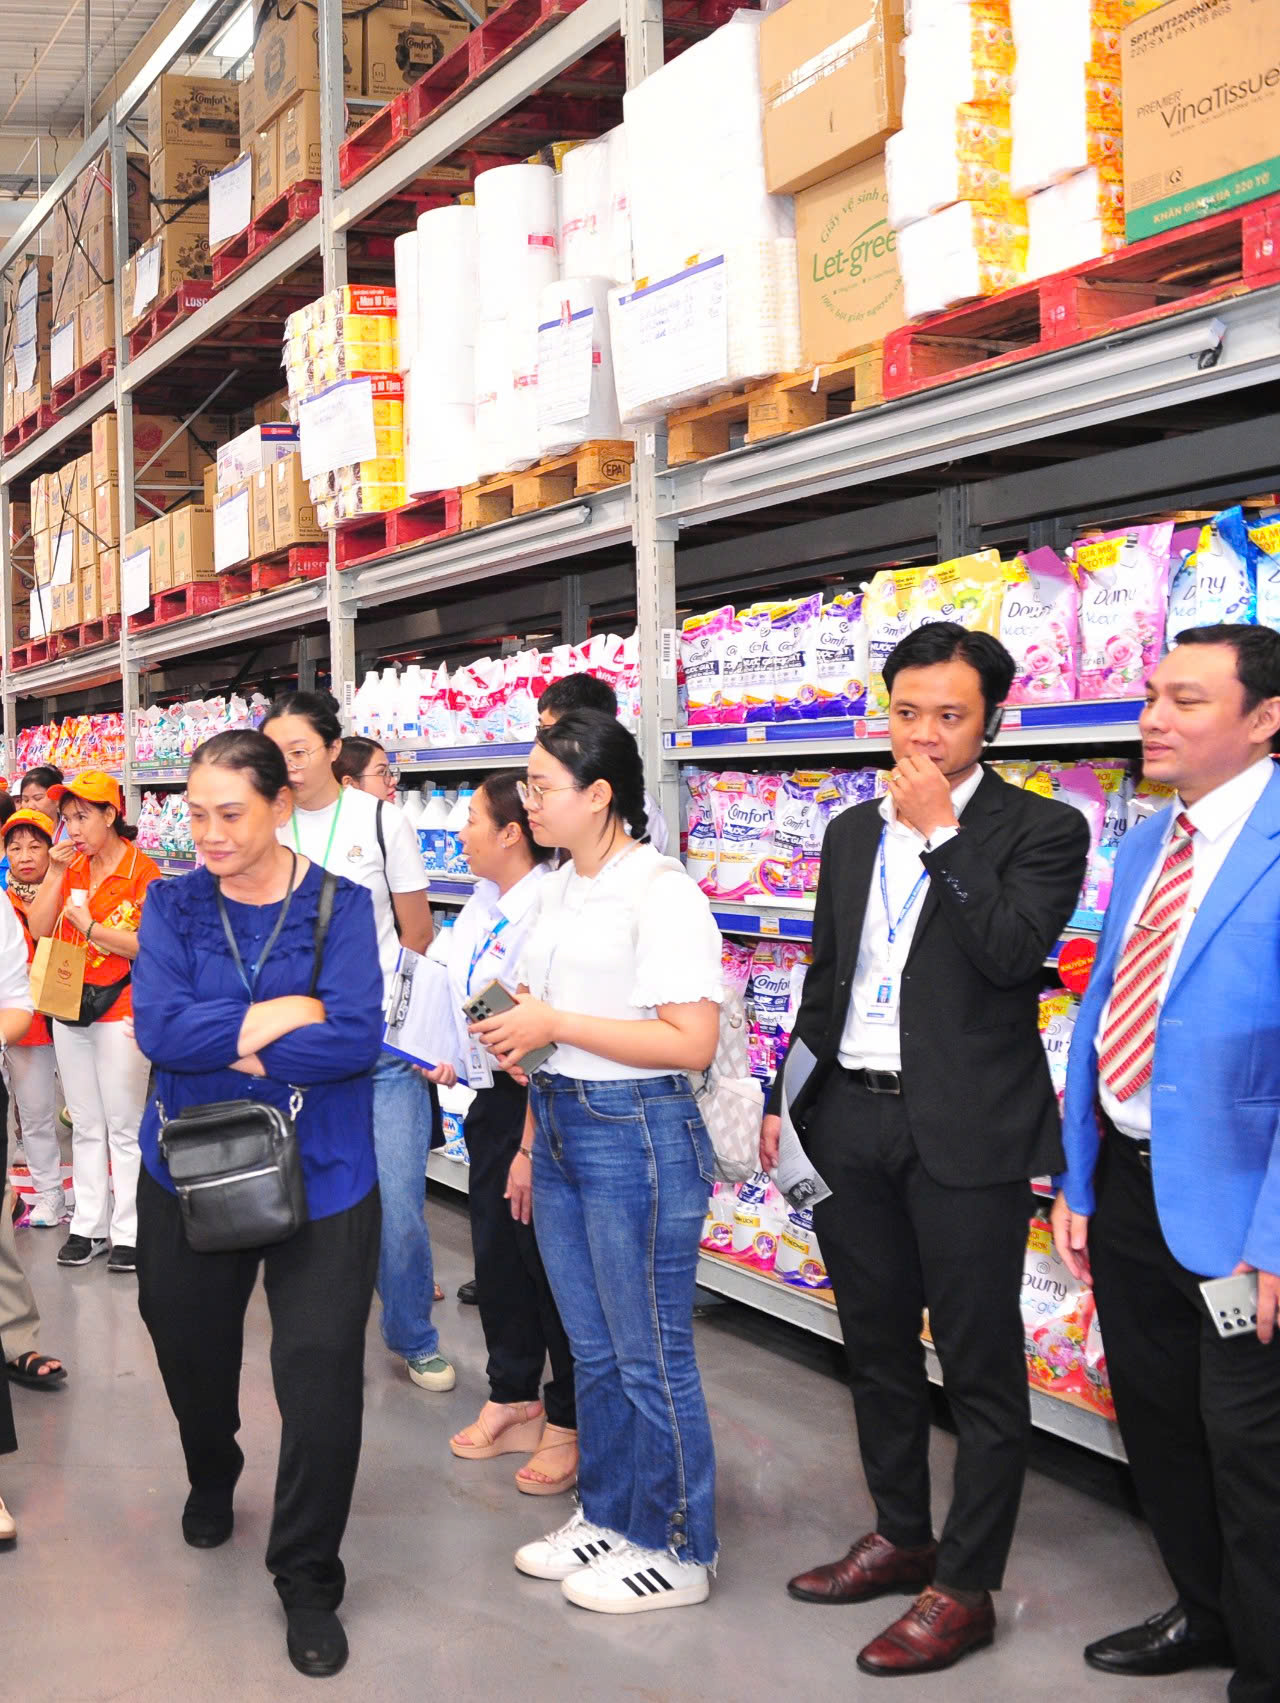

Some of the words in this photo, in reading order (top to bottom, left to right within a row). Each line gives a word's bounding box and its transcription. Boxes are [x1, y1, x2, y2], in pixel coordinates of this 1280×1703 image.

[1160, 67, 1280, 129] VinaTissue
[812, 230, 897, 283] Let-gree
[727, 803, 775, 825] Comfort
